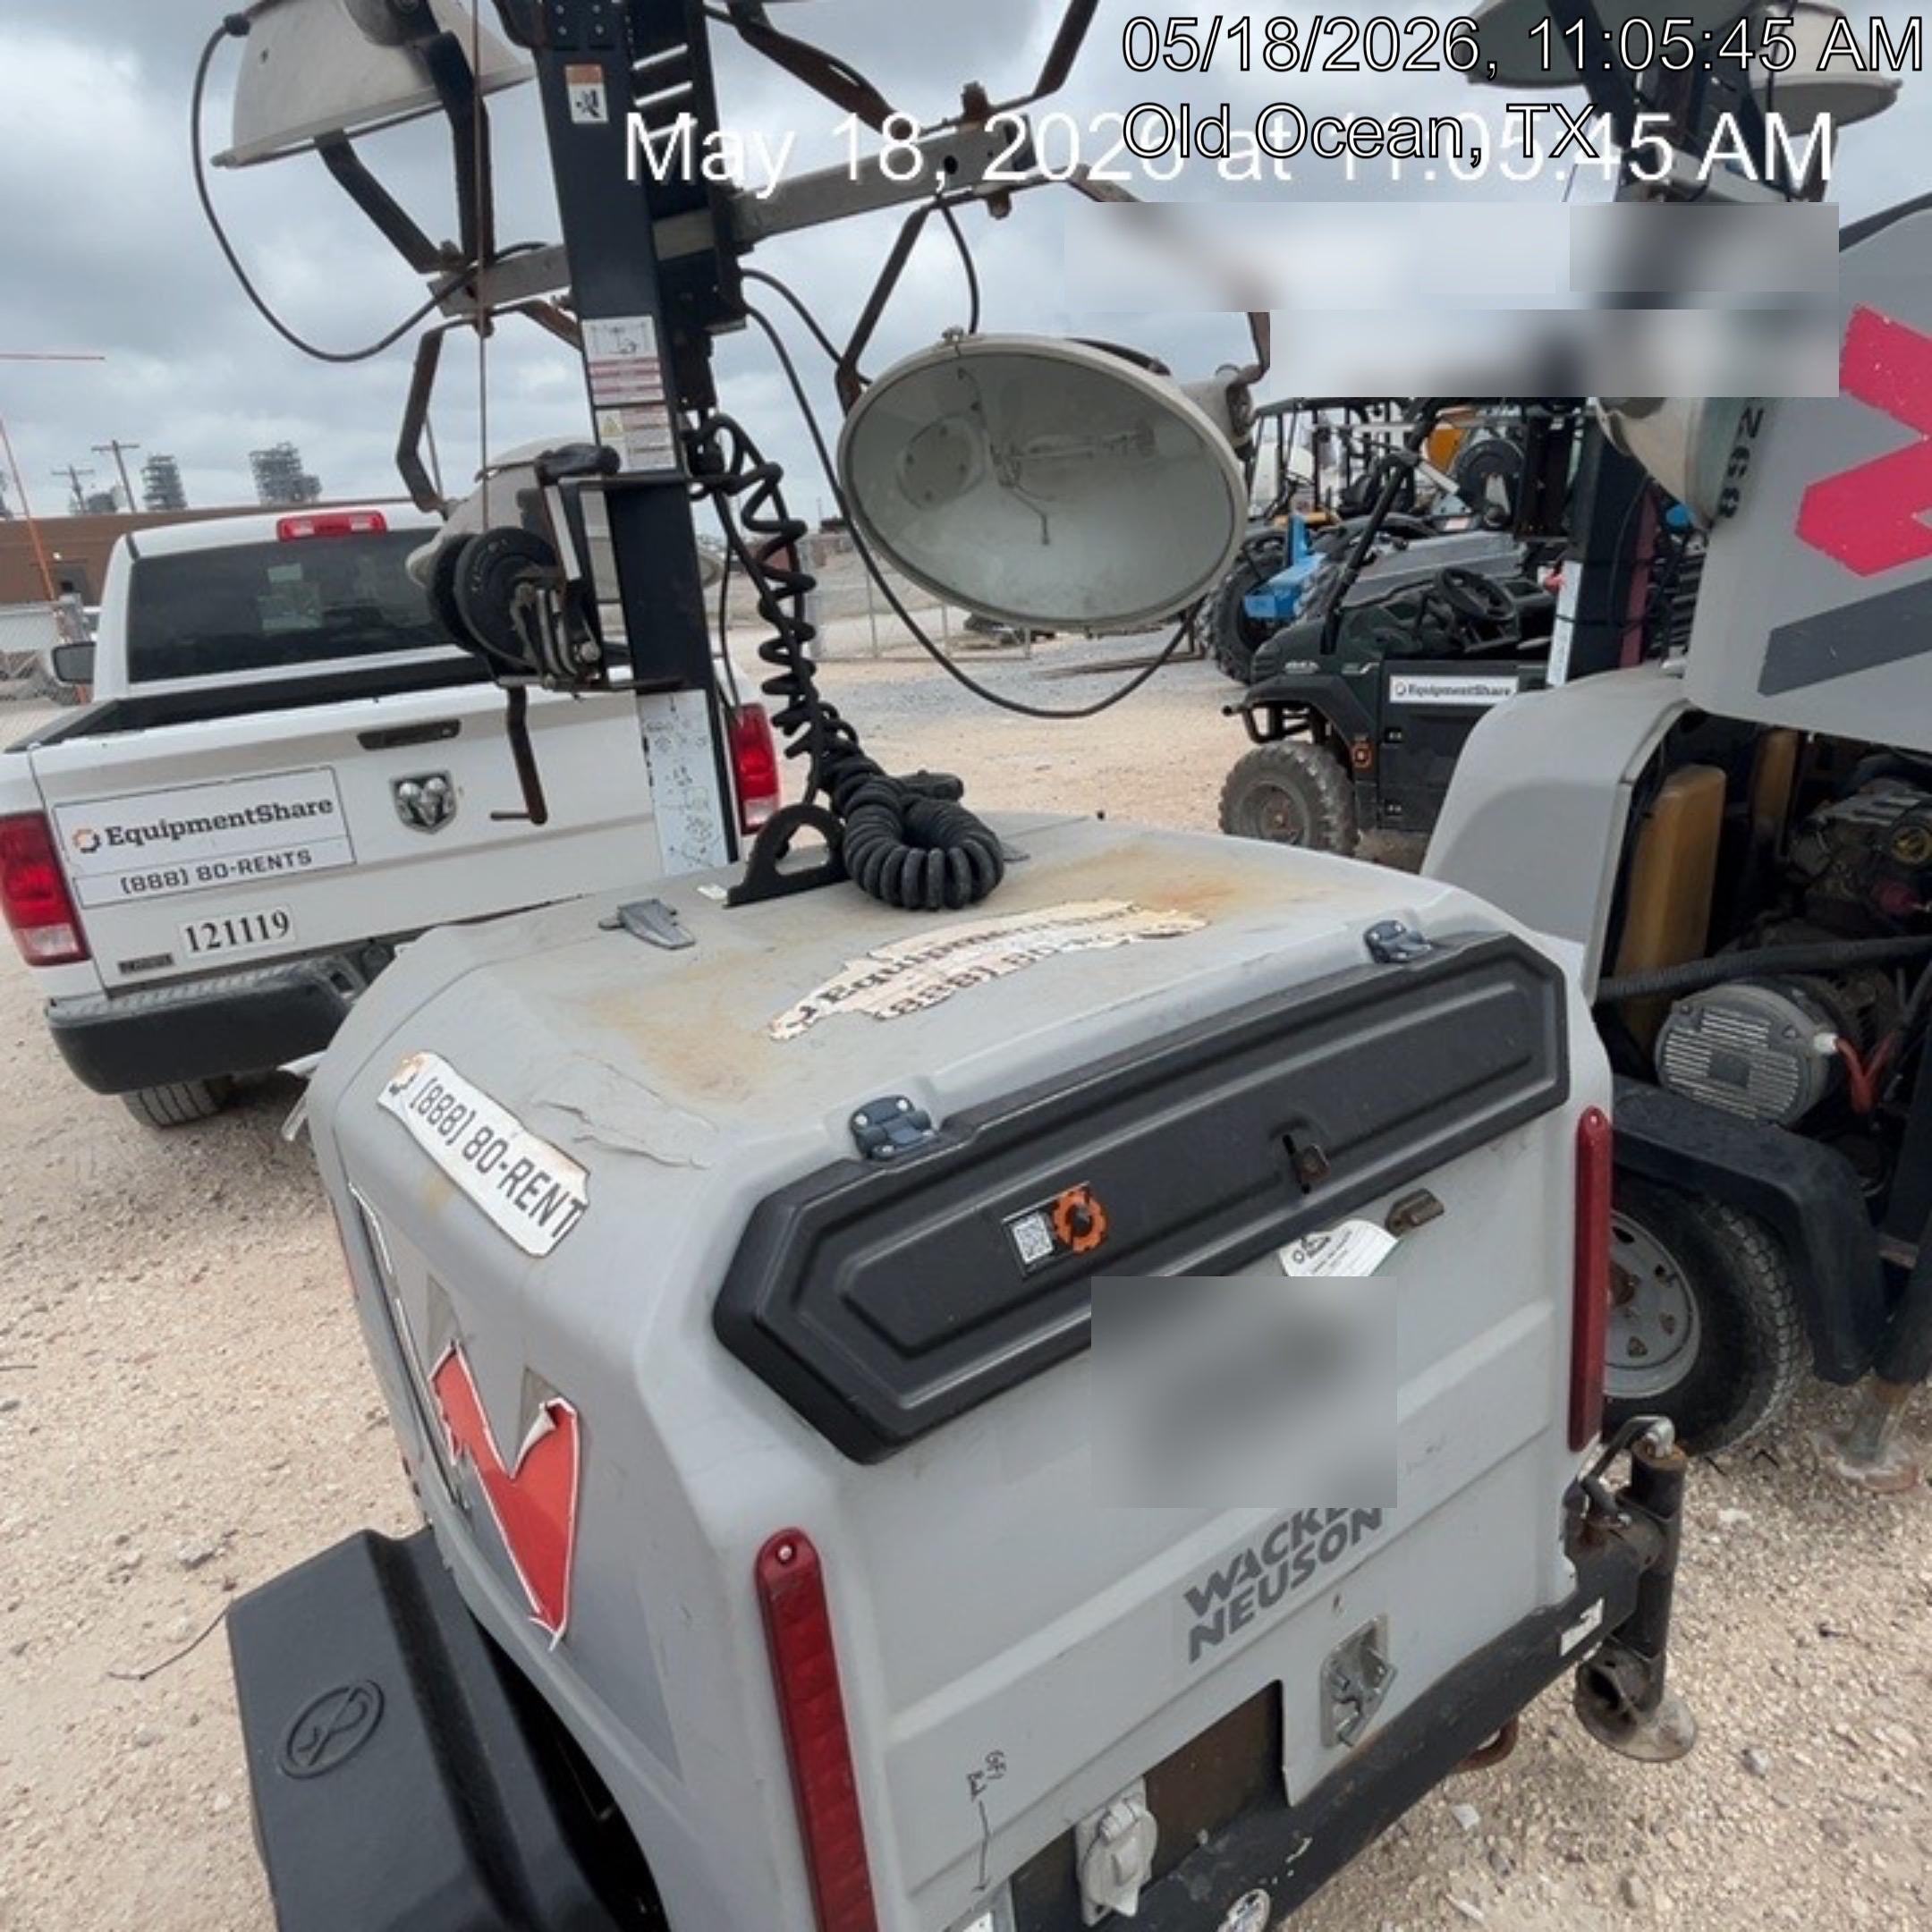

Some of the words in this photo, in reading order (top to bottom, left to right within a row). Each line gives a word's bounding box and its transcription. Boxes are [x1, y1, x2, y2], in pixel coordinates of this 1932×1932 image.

[104, 797, 335, 847] EquipmentShare
[119, 867, 191, 895] (888)
[195, 849, 313, 881] 80-RENTS
[185, 909, 291, 953] 121119
[410, 1076, 477, 1147] (888)
[1188, 1507, 1383, 1665] NEUSON
